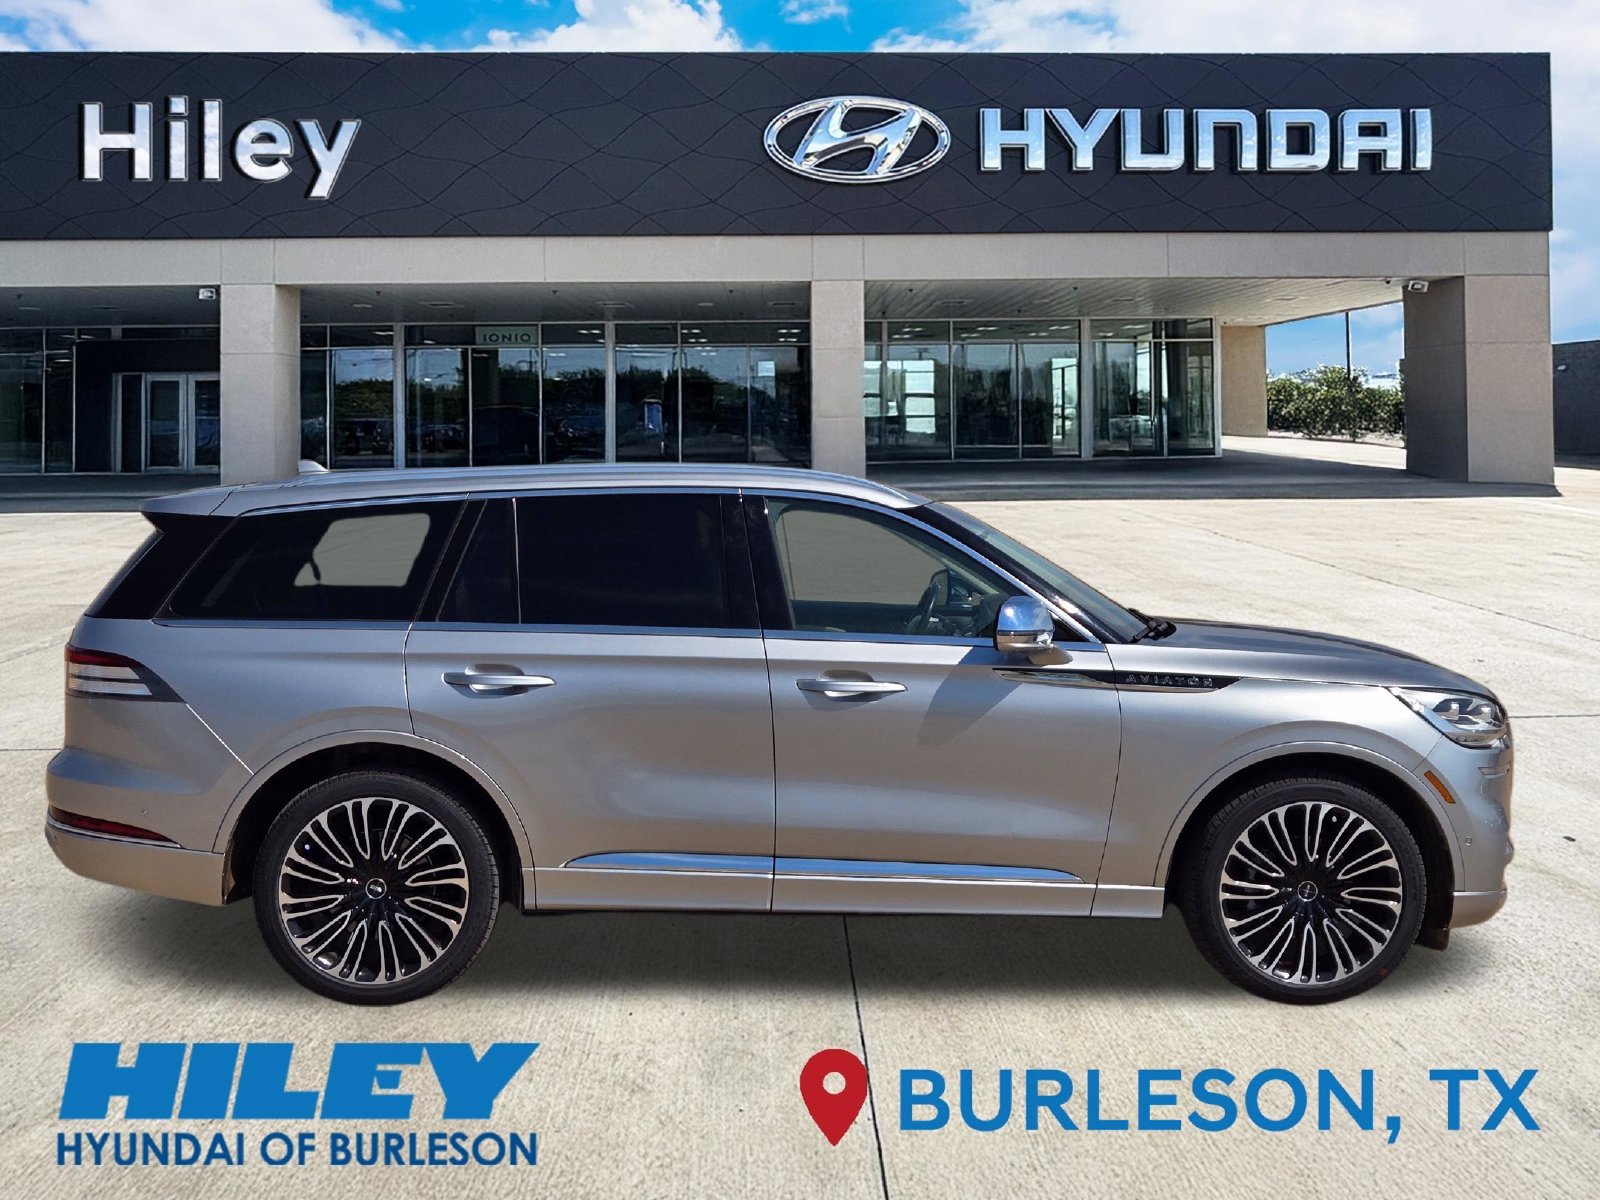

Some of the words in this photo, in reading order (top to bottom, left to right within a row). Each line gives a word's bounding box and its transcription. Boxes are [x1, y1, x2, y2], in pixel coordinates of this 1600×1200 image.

[80, 95, 362, 199] Hiley
[979, 107, 1433, 172] HYUNDAI
[1125, 674, 1213, 687] AVIATOR
